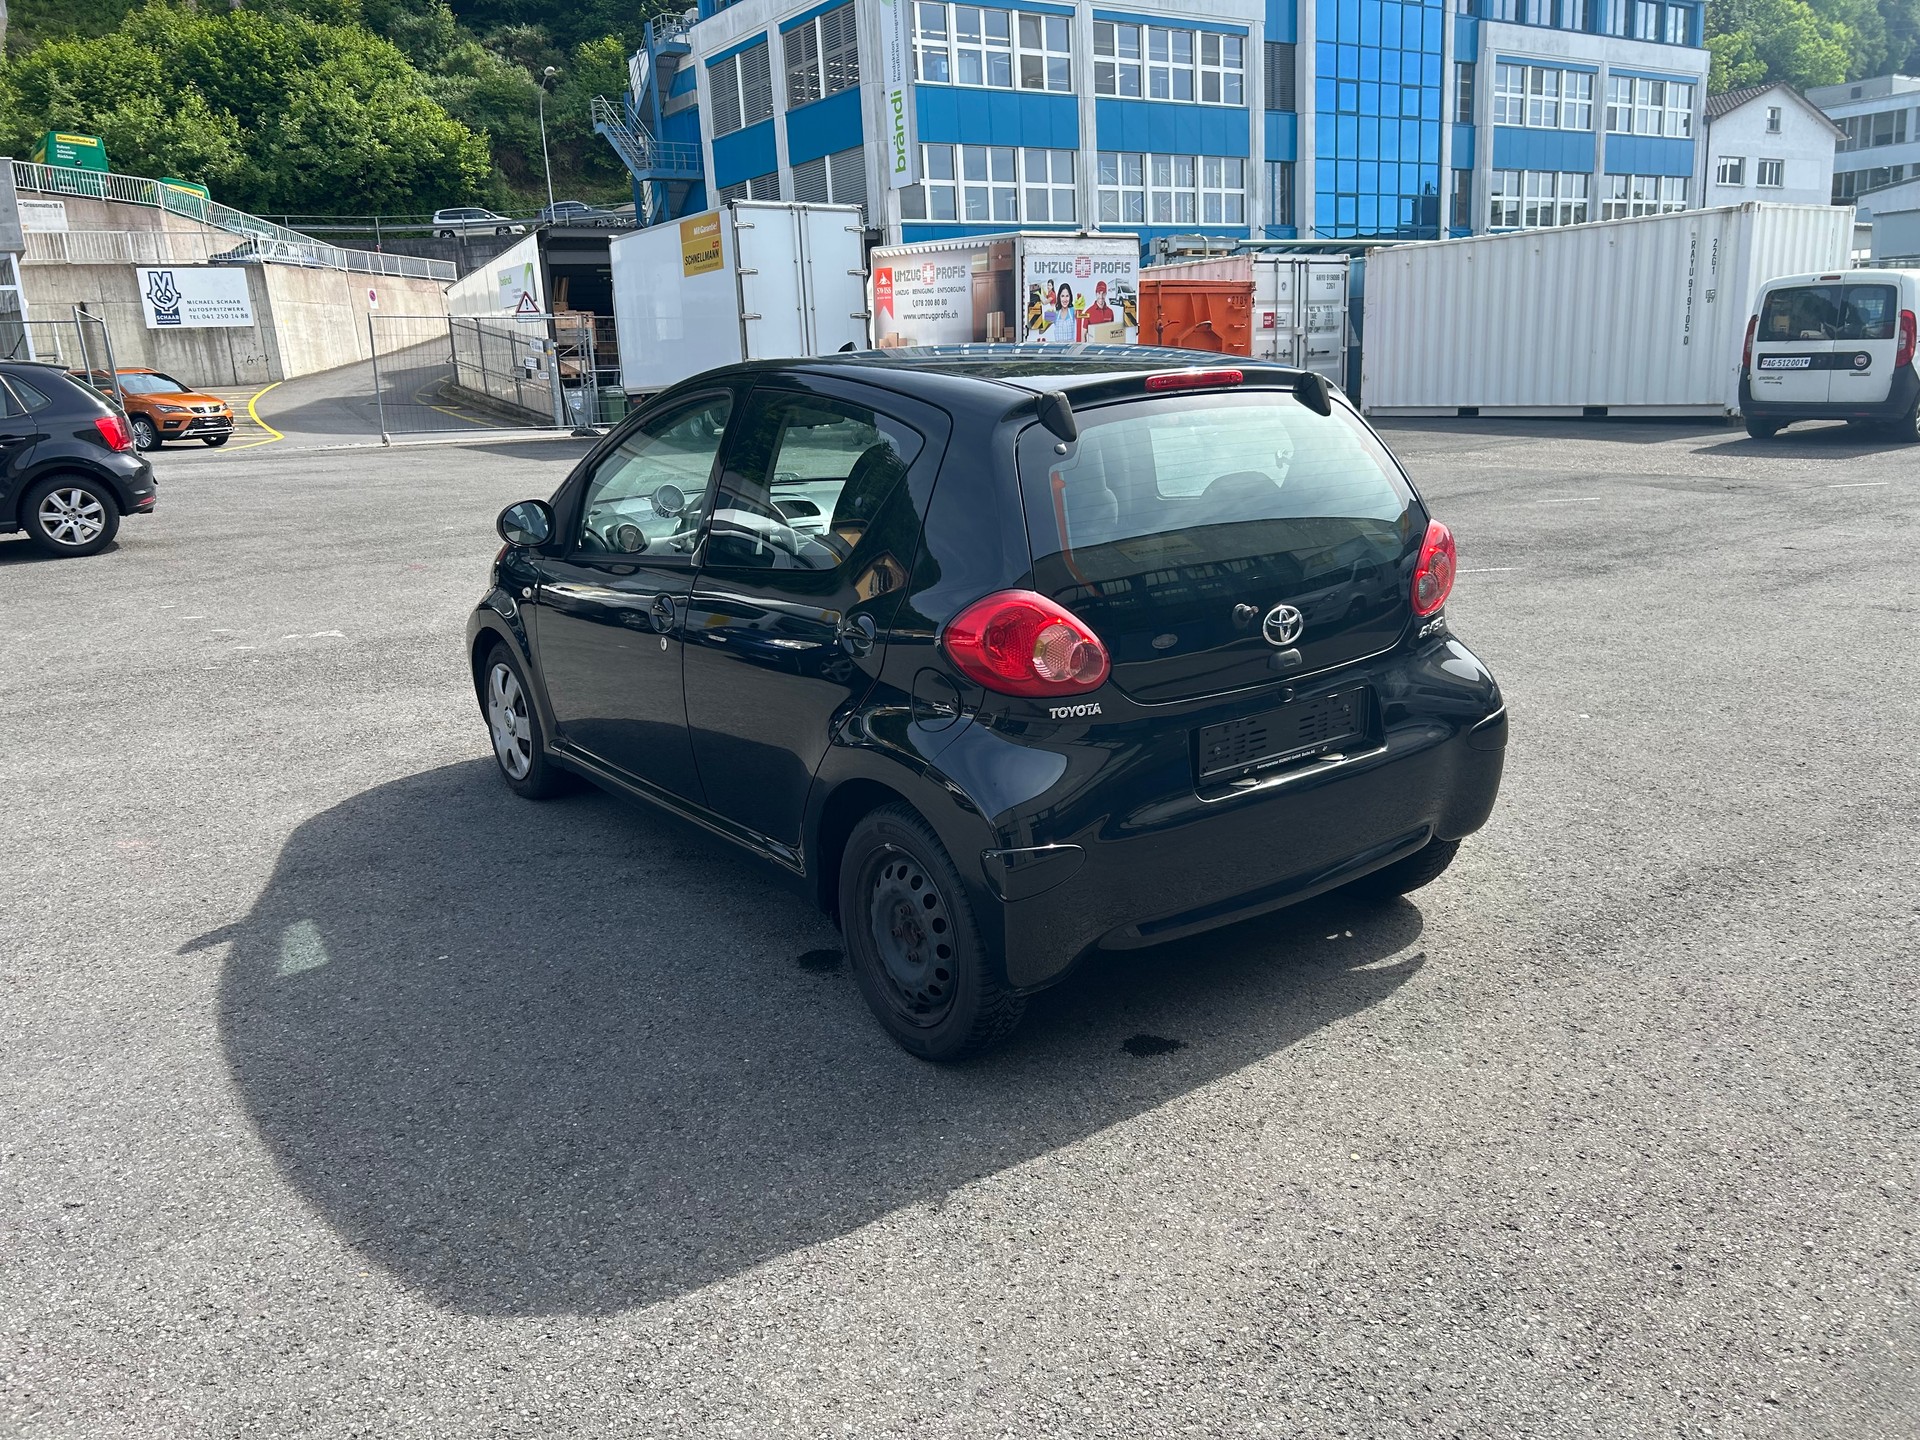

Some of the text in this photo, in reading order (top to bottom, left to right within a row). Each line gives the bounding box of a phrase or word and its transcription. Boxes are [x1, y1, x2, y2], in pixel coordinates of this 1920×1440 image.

[890, 89, 907, 174] brändi
[685, 248, 720, 266] SCHNELLMANN
[1689, 240, 1697, 277] RAYU
[894, 265, 966, 282] UMZUG PROFIS
[1034, 261, 1131, 274] UMZUG PROFIS
[937, 286, 966, 294] ENTSORGUNG
[941, 298, 948, 306] 80
[1684, 279, 1694, 333] 919105
[903, 310, 959, 321] www.umzugprofis.ch
[1049, 702, 1102, 719] TOYOTA
